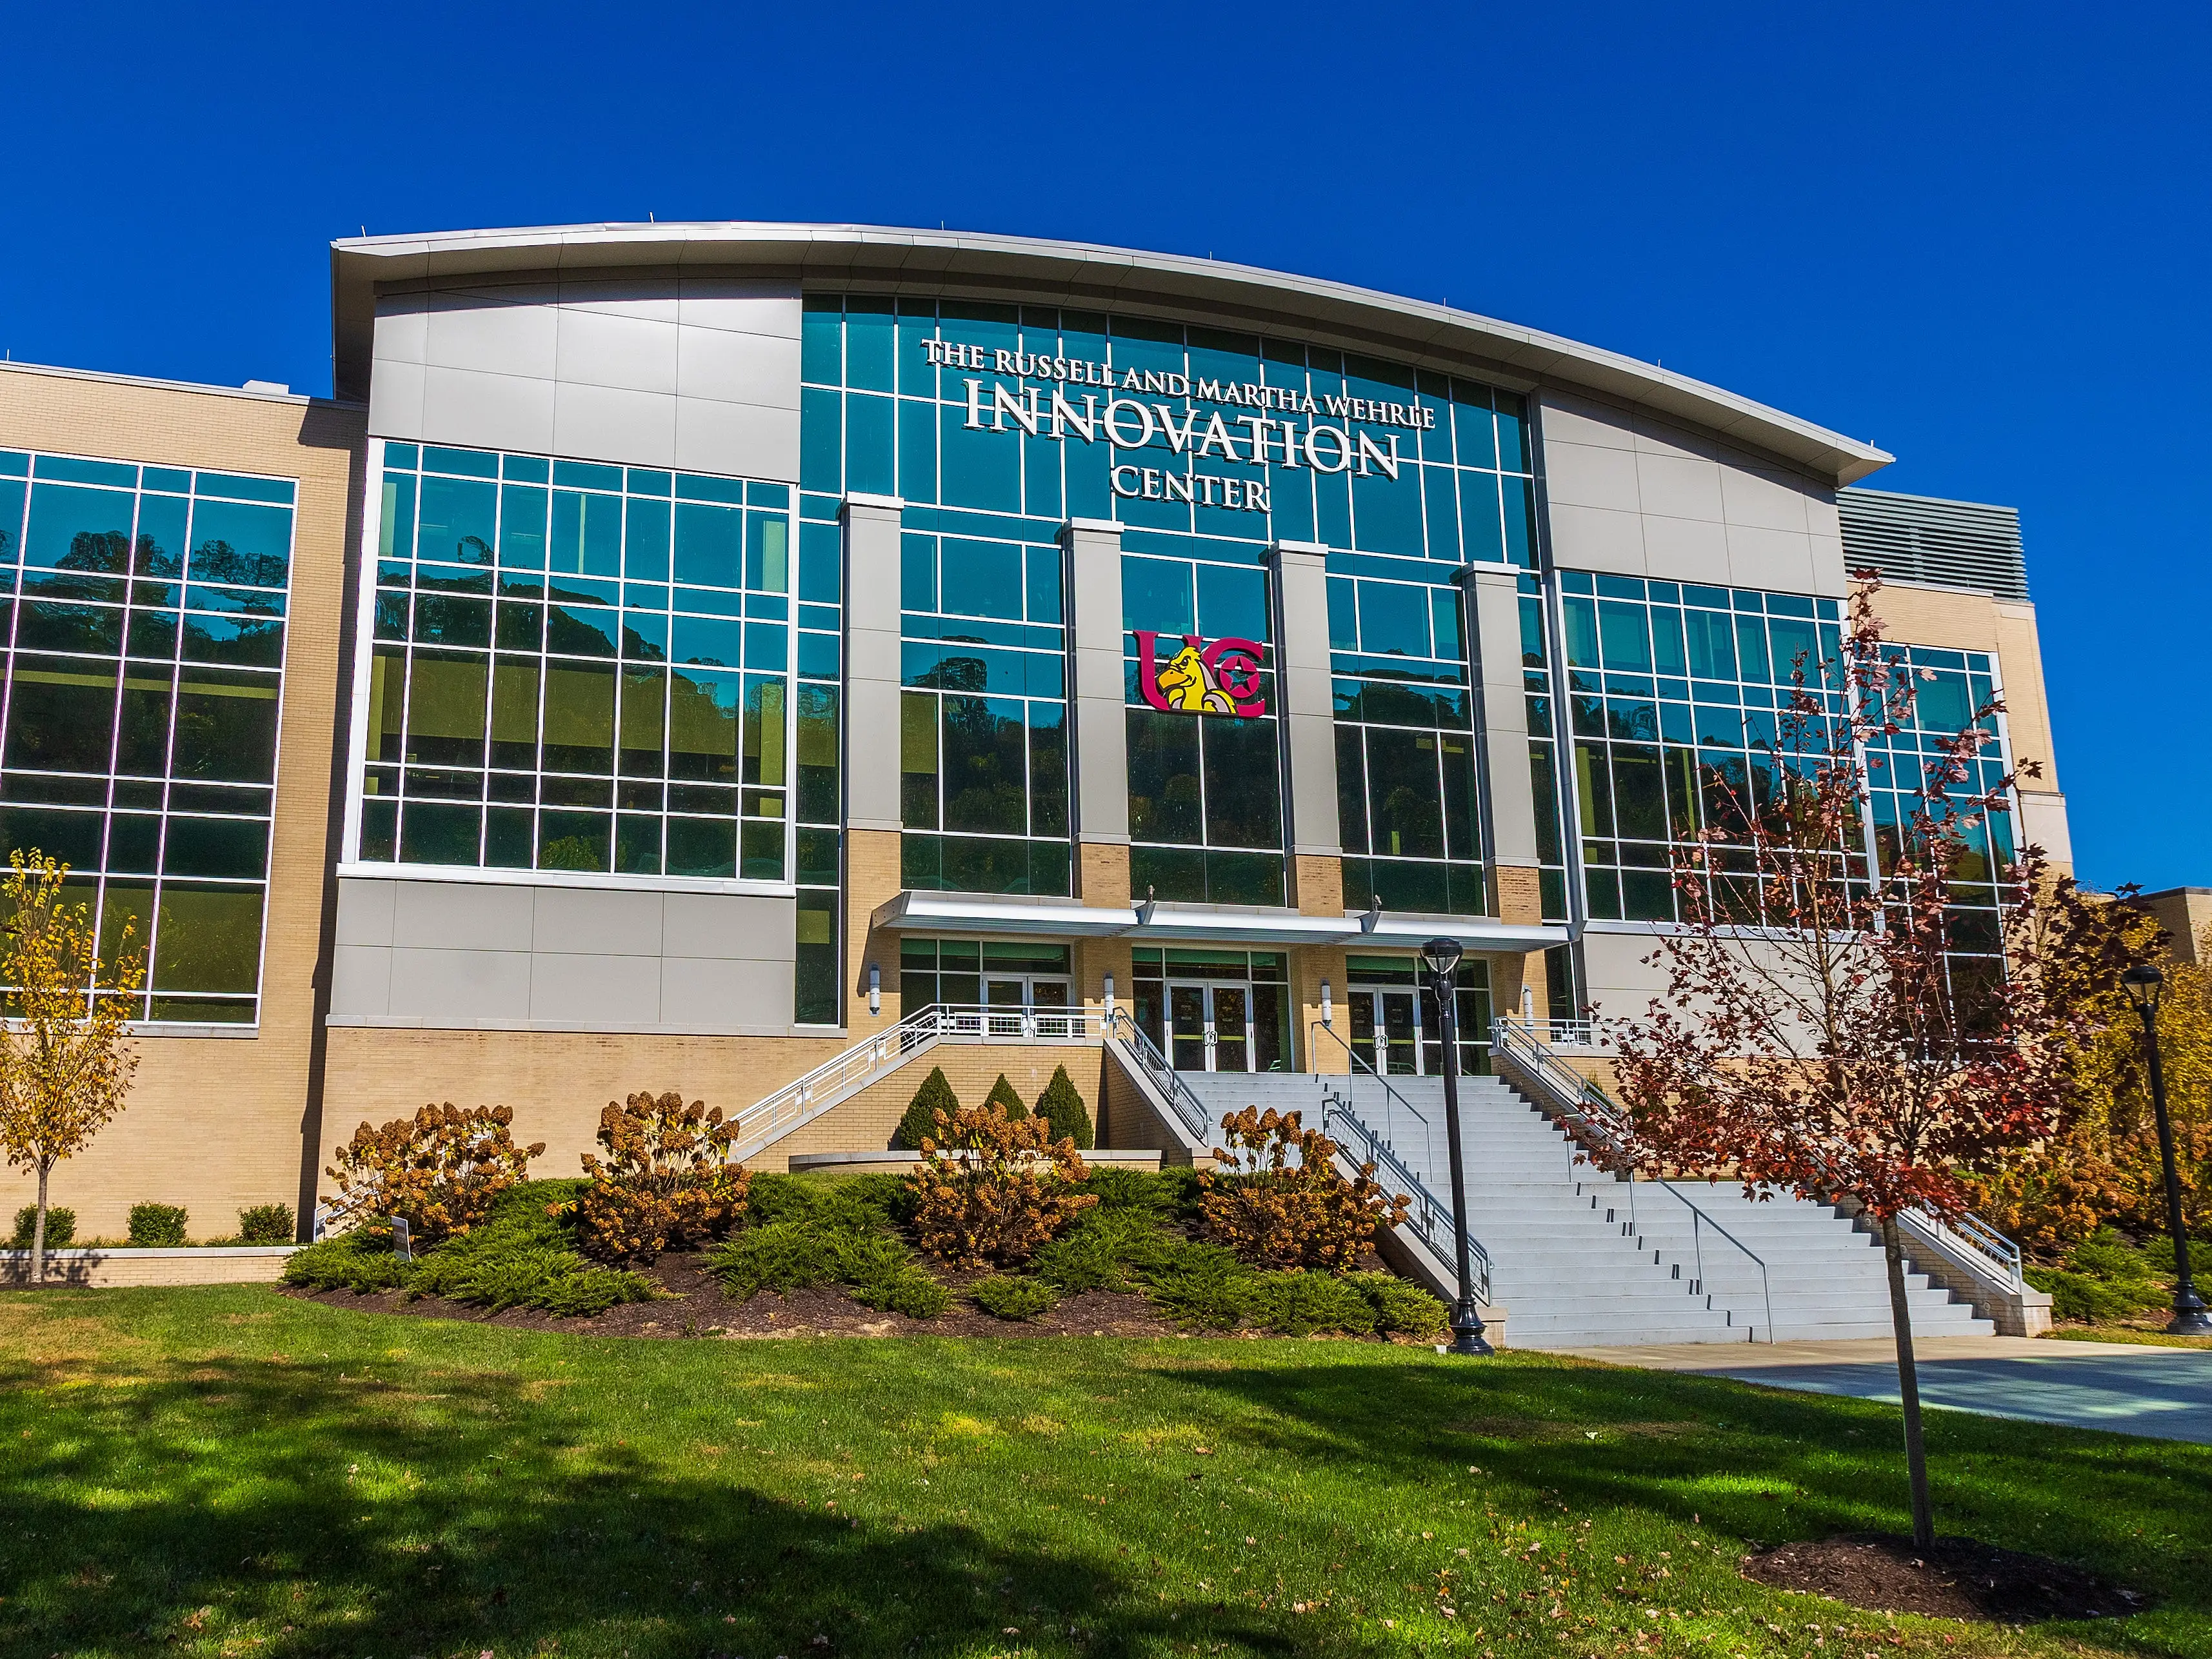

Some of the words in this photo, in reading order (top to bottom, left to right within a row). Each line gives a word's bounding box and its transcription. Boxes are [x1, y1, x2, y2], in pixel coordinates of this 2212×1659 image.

[921, 339, 985, 369] THE
[994, 348, 1117, 386] RUSSELL
[1121, 366, 1190, 396] AND
[1196, 377, 1320, 414] MARTHA
[1324, 393, 1436, 430] WEHRLE
[963, 378, 1400, 480] INNOVATION
[1111, 464, 1273, 512] CENTER
